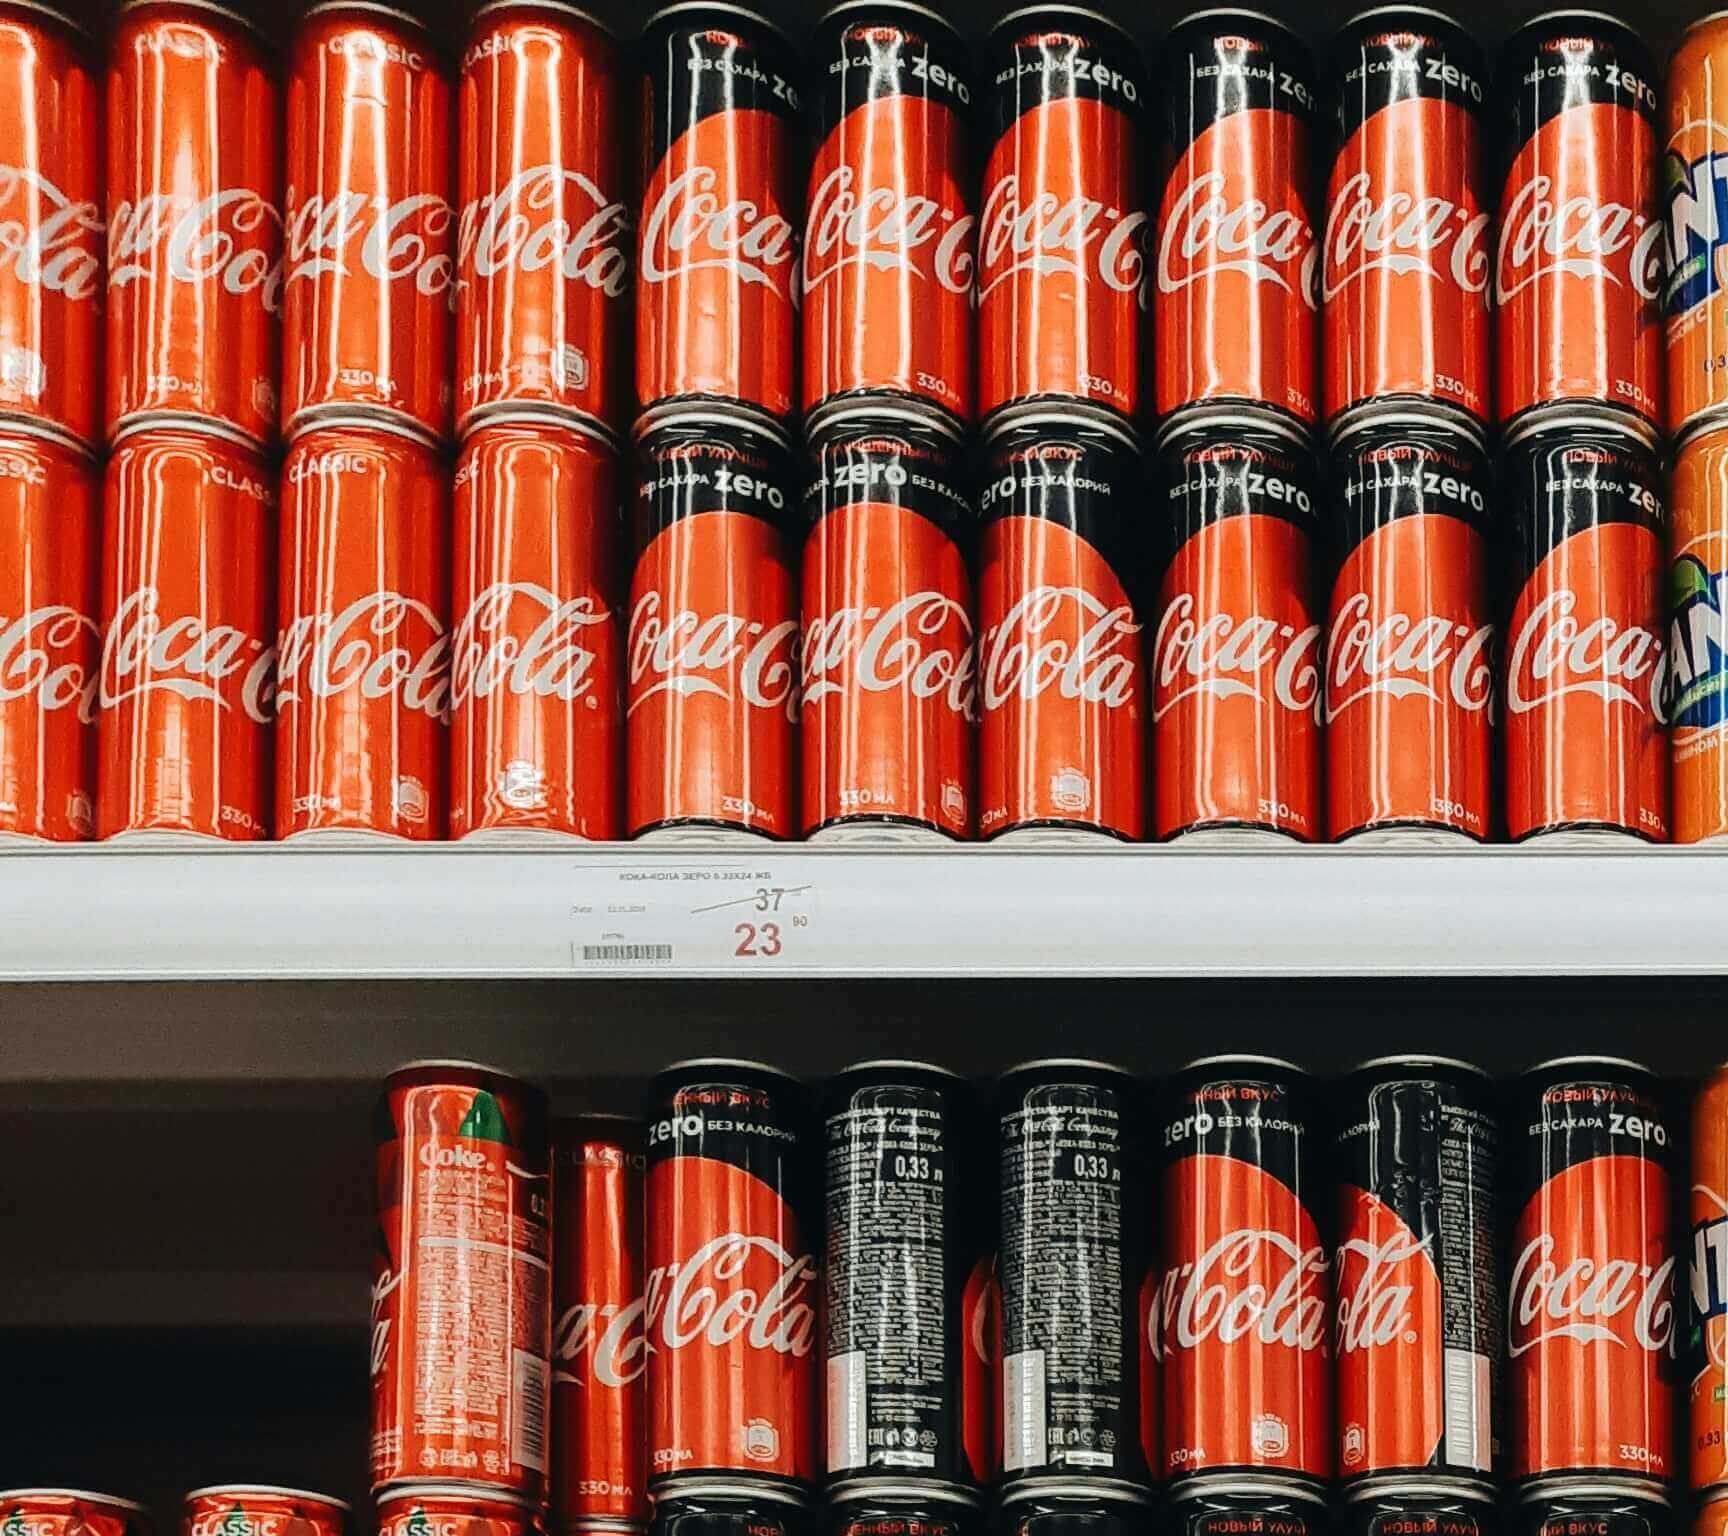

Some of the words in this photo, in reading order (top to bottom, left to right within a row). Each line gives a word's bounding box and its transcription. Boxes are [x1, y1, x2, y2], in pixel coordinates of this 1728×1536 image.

[912, 55, 970, 105] zero
[1074, 56, 1136, 103] zero
[1425, 56, 1482, 103] zero
[714, 468, 783, 510] zero
[834, 457, 907, 489] zero
[1249, 470, 1311, 512] zero
[1423, 470, 1485, 511] zero
[755, 888, 785, 911] 37
[735, 923, 781, 957] 23
[792, 915, 808, 926] 90
[648, 1111, 702, 1145] zero
[895, 1156, 928, 1180] 0,33
